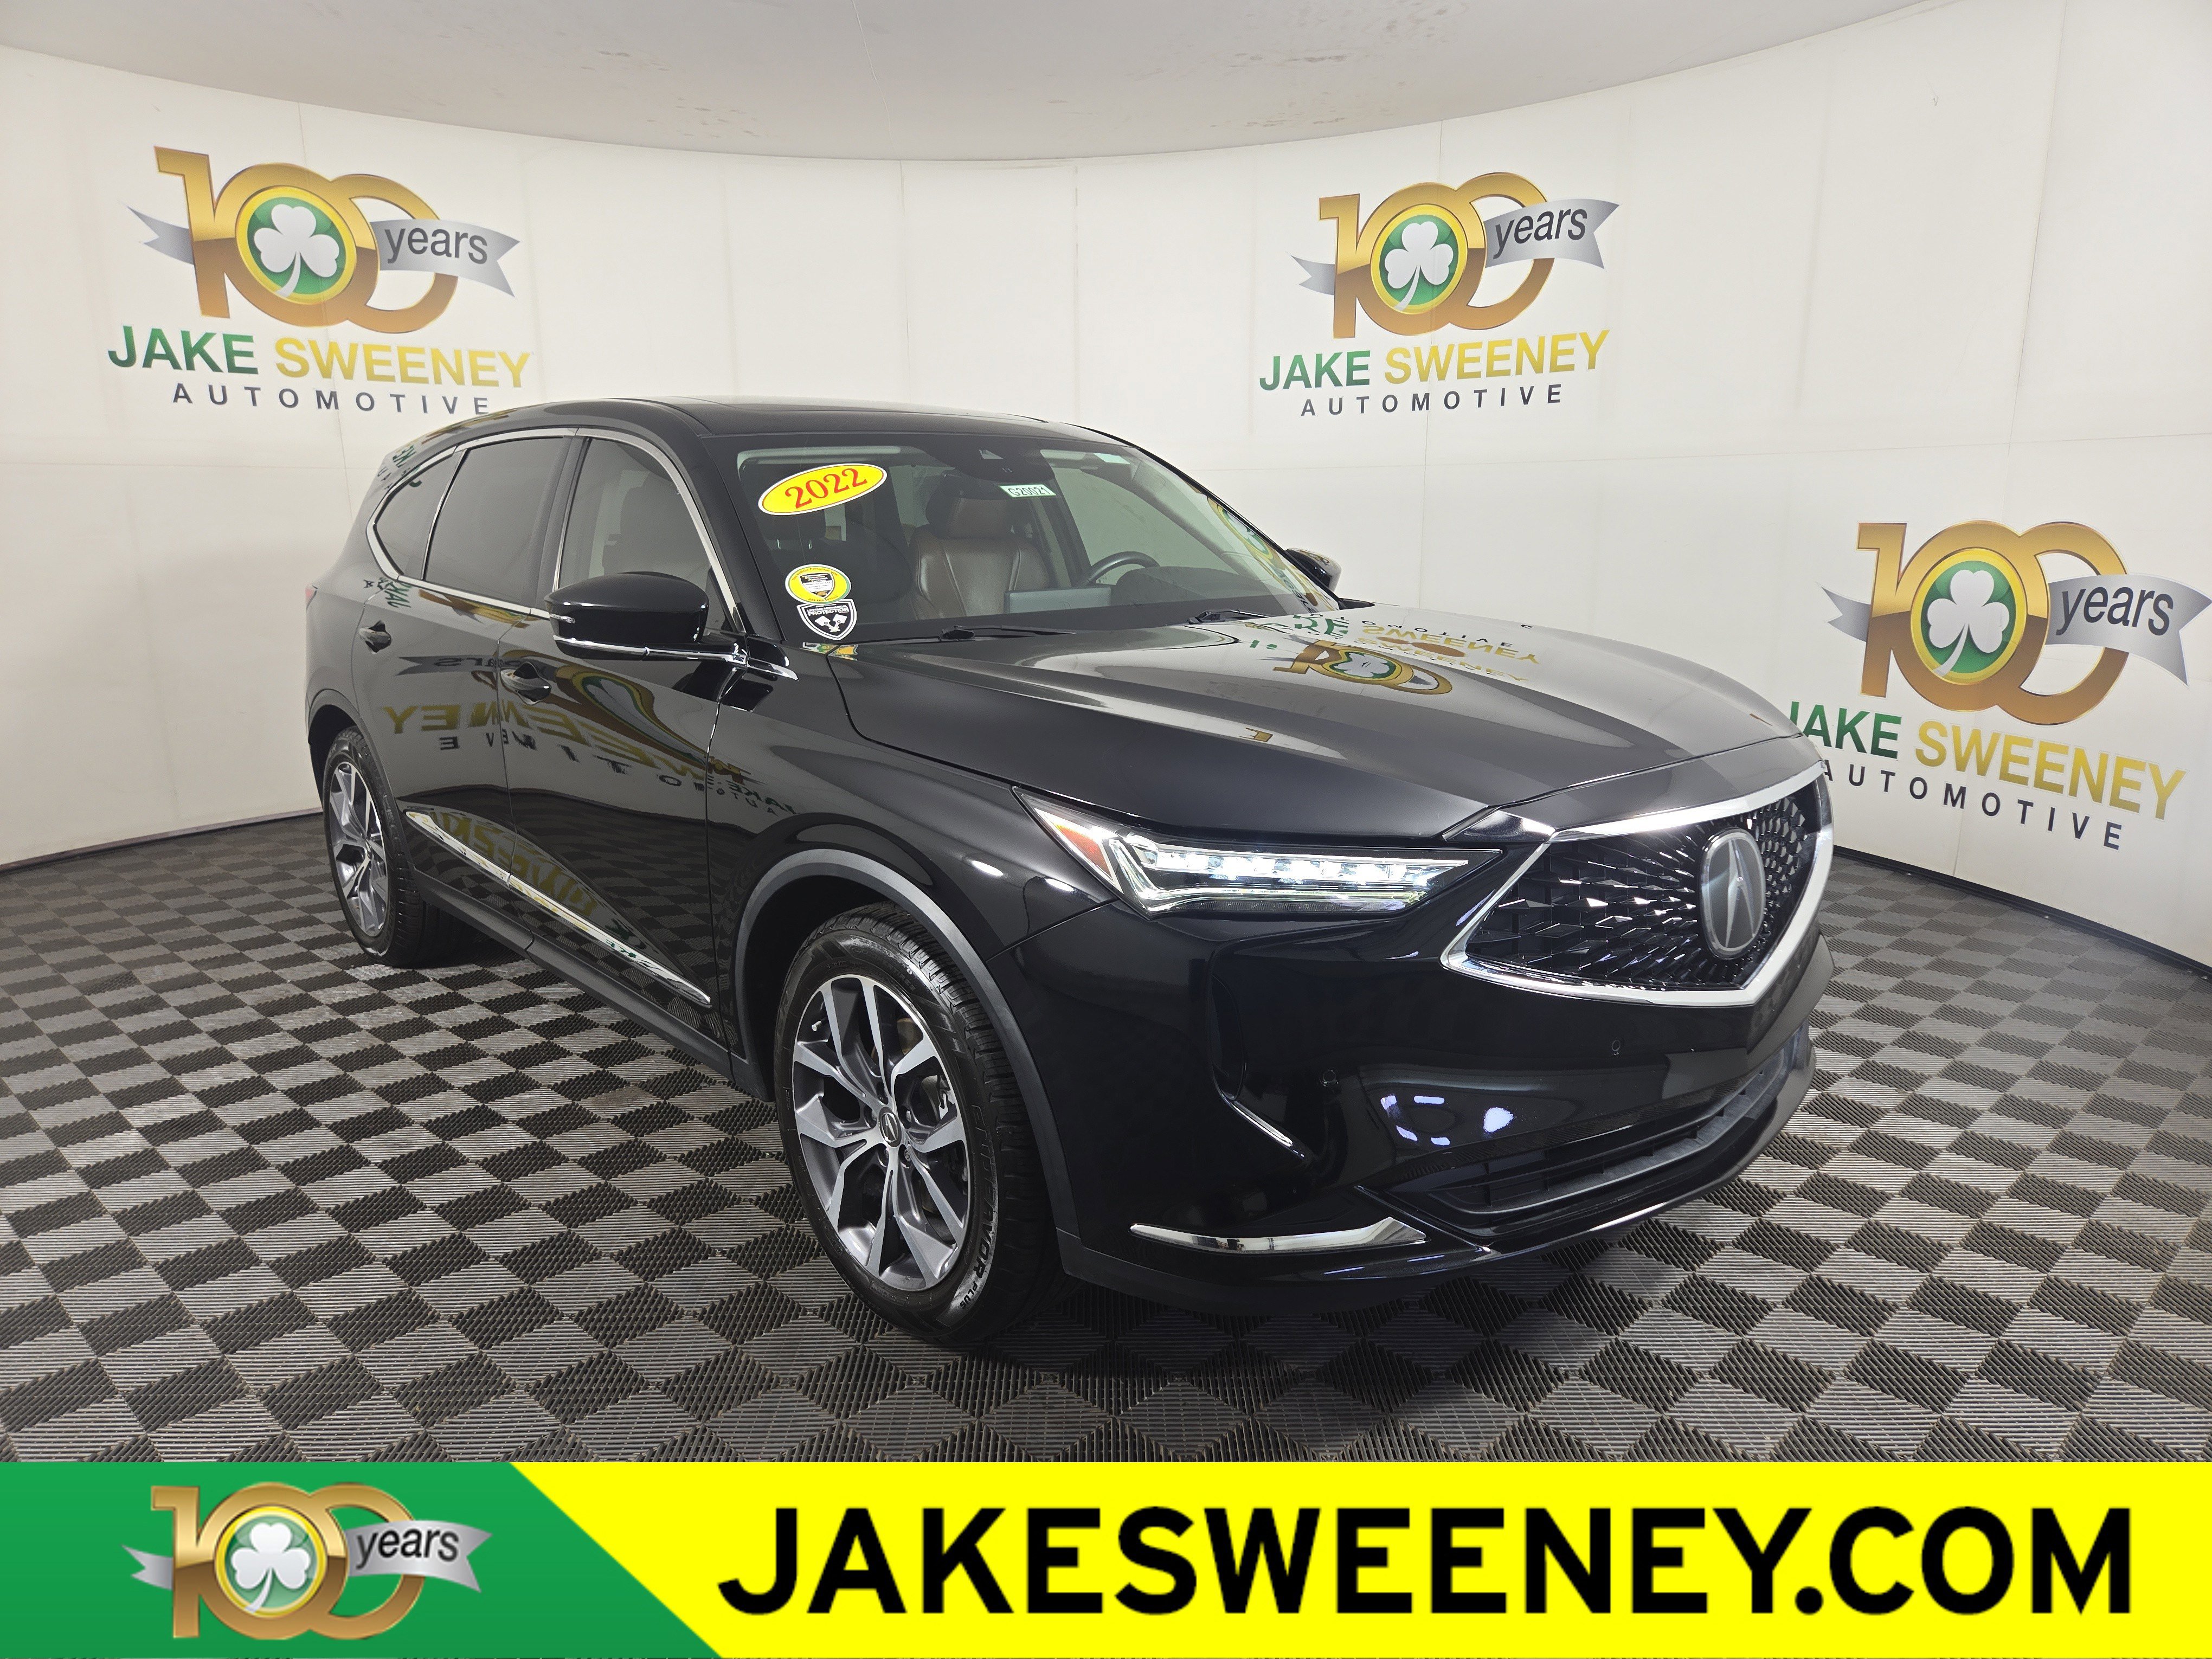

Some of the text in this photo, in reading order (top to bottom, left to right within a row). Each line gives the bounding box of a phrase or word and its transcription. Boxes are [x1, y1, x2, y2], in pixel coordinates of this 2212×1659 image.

[154, 145, 488, 334] 100 years
[1319, 171, 1588, 339] 100 years
[108, 325, 531, 389] JAKE SWEENEY
[1259, 329, 1610, 391] JAKE SWEENEY
[172, 383, 490, 415] AUTOMOTIVE
[1300, 383, 1562, 417] AUTOMOTIVE
[785, 467, 869, 510] 2022
[1008, 486, 1051, 496] G20021
[807, 607, 850, 616] PROTECTION
[1856, 519, 2174, 725] 100 years
[1915, 721, 2187, 821] SWEENEY
[959, 1281, 979, 1310] PLUS
